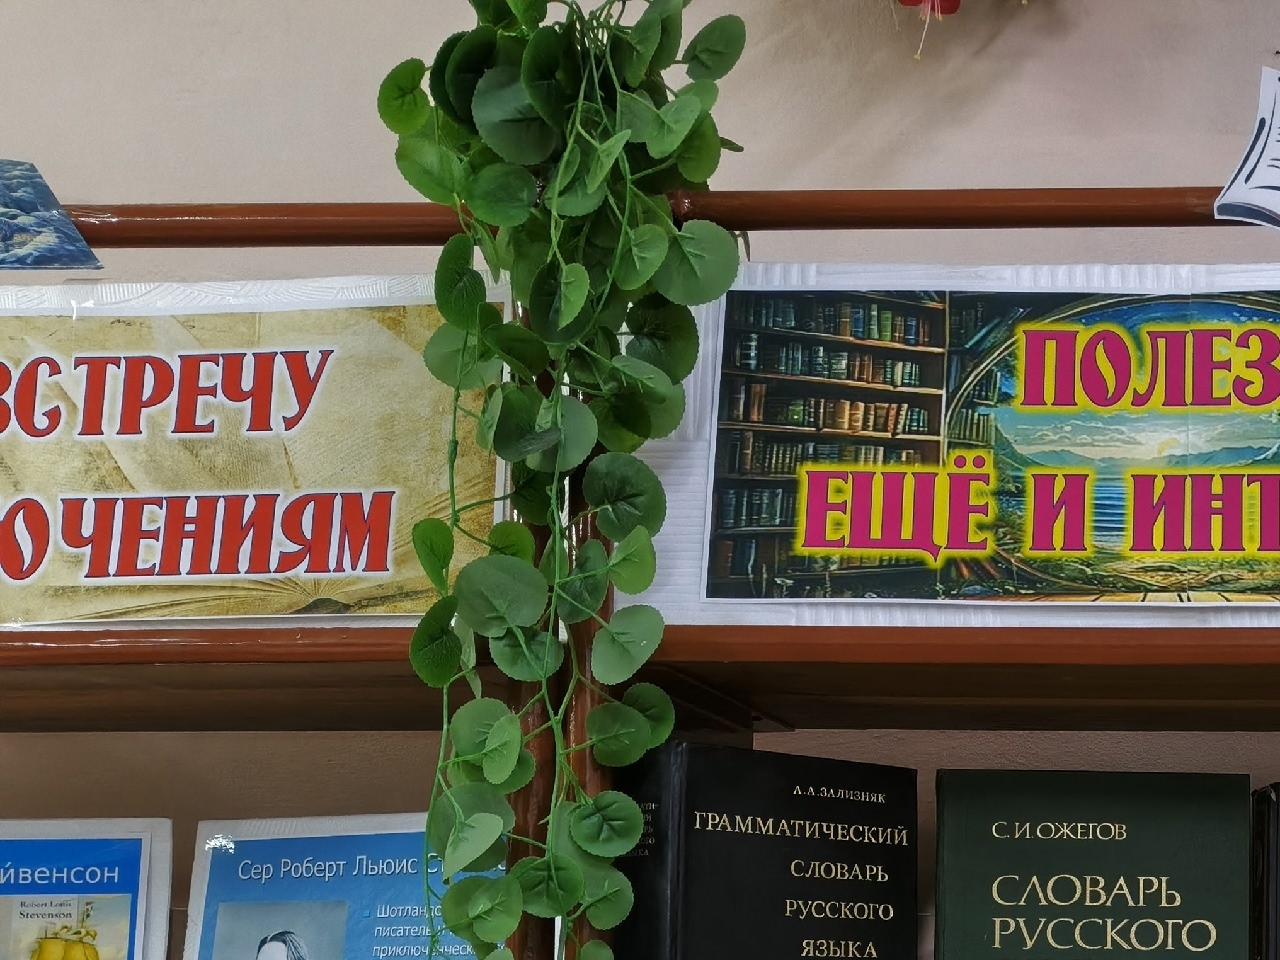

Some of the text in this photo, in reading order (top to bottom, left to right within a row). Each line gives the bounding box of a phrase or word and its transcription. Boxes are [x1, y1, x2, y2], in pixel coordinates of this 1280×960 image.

[801, 454, 990, 562] ЕЩЁ
[1030, 473, 1090, 552] И
[693, 811, 908, 847] ГРАММАТИЧЕСКИЙ
[238, 860, 274, 883] Сер
[280, 857, 347, 881] Роберт
[353, 855, 418, 877] Льюис
[789, 859, 889, 883] СЛОВАРЬ
[991, 874, 1182, 908] СЛОВАРЬ
[784, 899, 895, 921] РУССКОГО
[801, 939, 878, 960] ЯЗЫКА
[991, 917, 1217, 951] РУССКОГО
